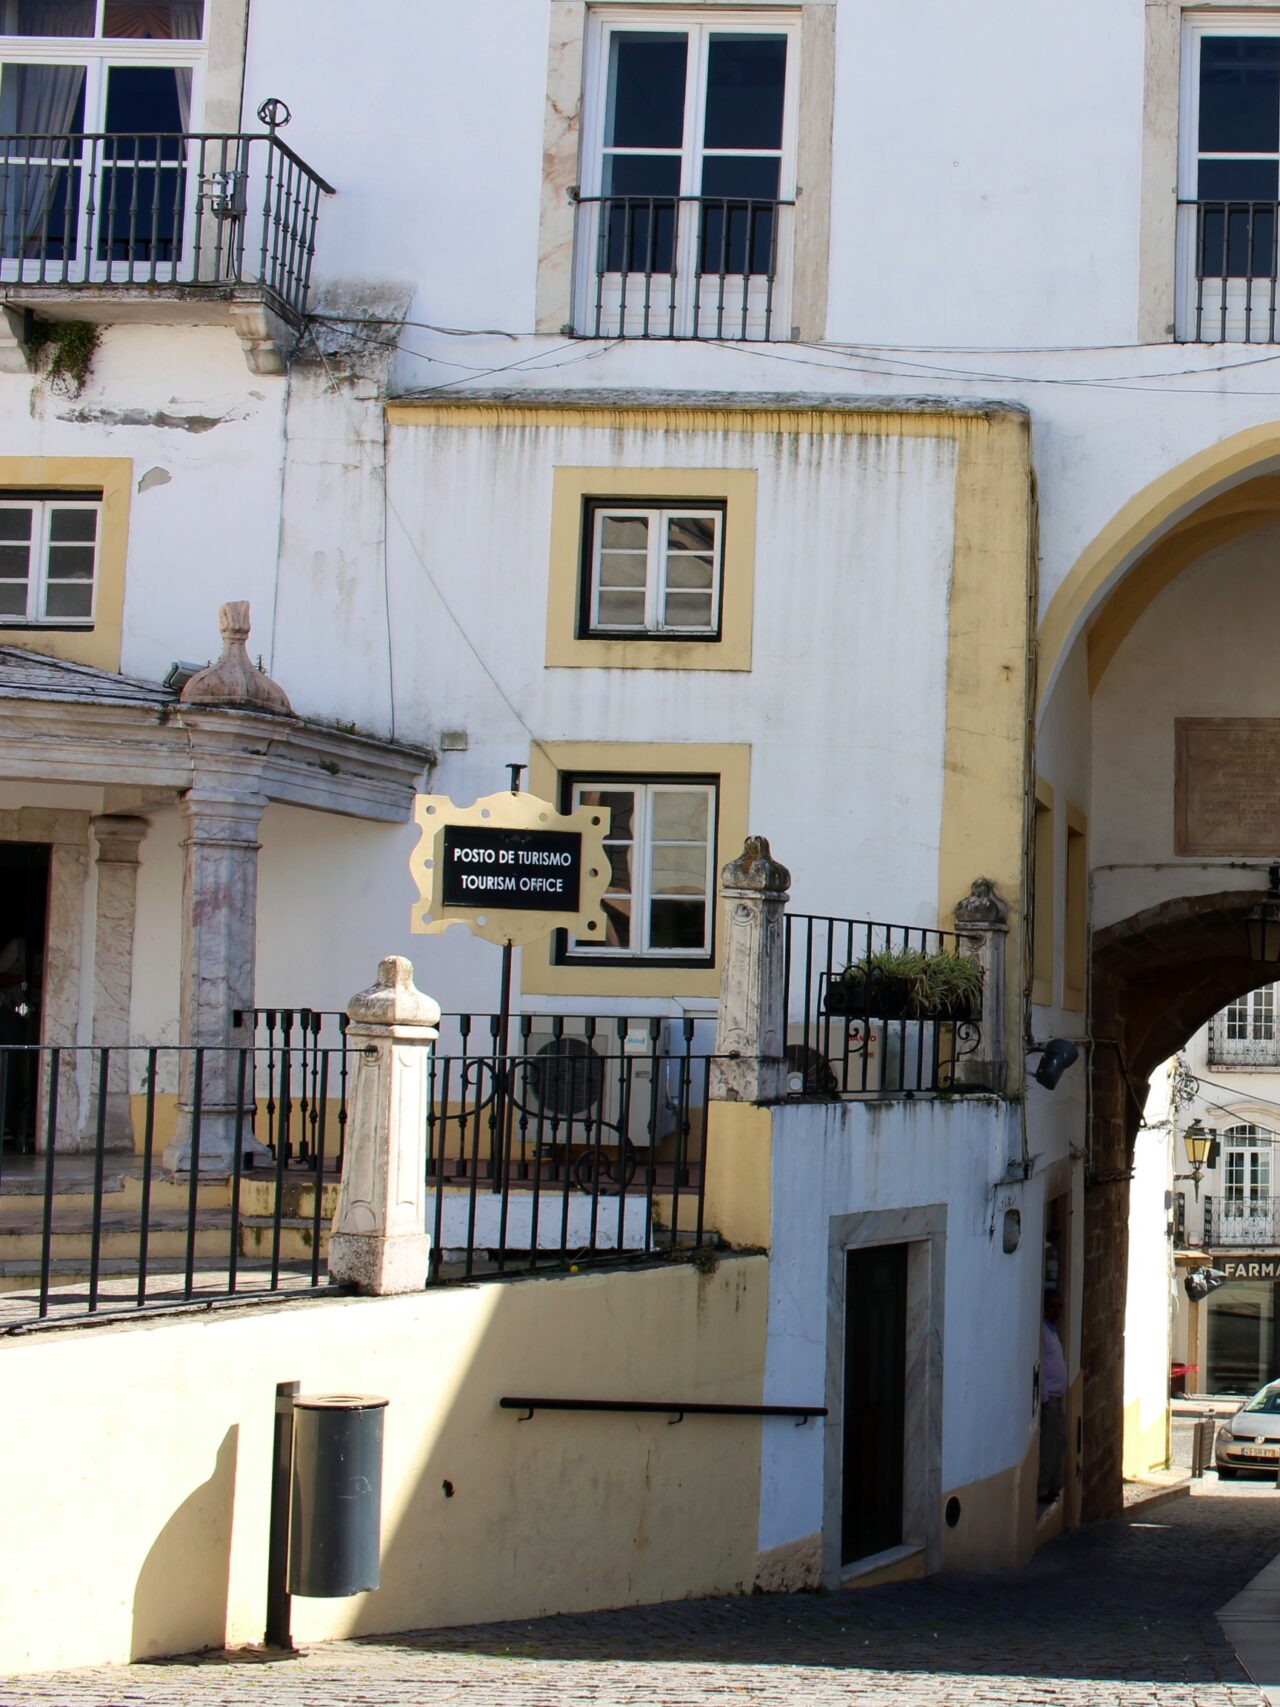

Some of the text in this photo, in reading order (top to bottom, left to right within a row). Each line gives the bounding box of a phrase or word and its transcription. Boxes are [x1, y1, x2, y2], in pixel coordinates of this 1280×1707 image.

[453, 848, 571, 866] POSTO DE TURISMO
[461, 875, 563, 892] TOURISM OFFICE
